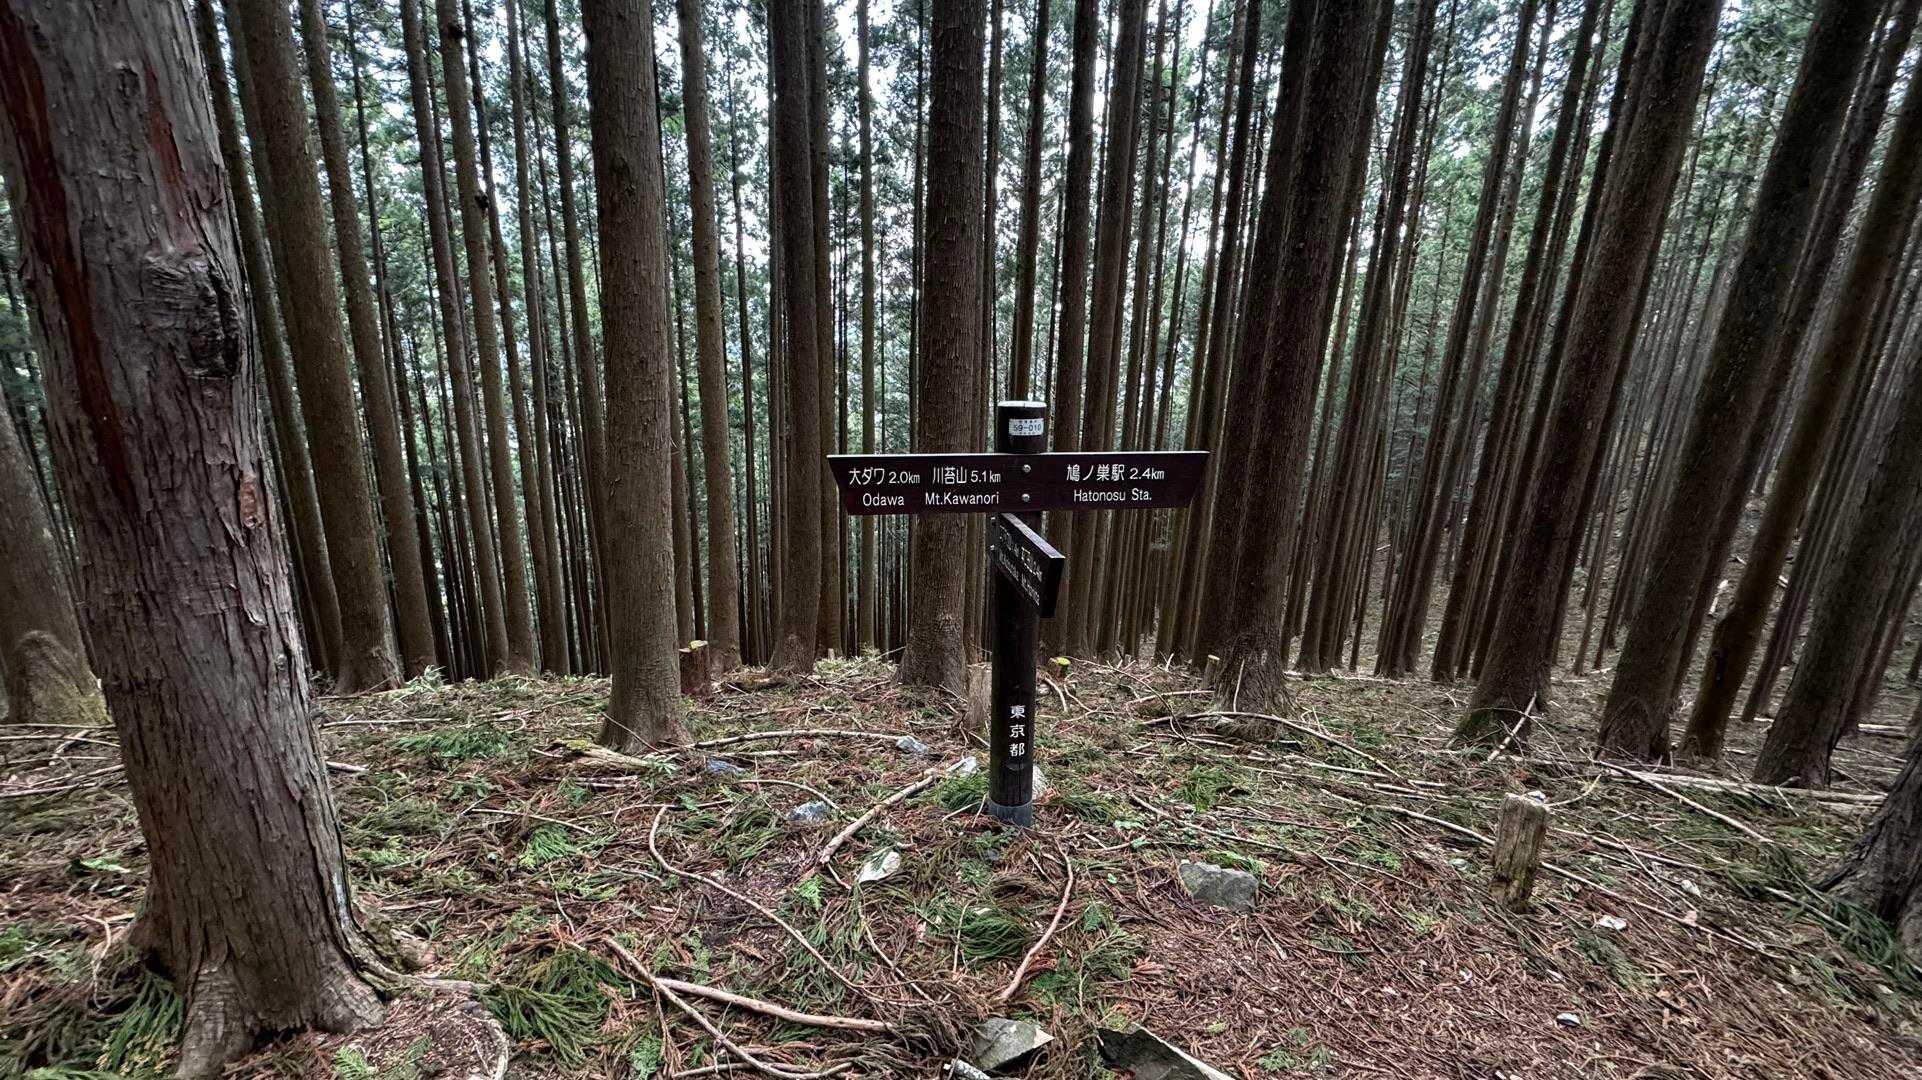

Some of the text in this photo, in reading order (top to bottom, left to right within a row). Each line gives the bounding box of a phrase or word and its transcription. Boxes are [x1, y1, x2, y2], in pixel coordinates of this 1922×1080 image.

[849, 466, 920, 485] 大ダワ 2.0km
[932, 466, 1001, 485] 川苔山 5.1km
[1066, 463, 1165, 482] 鳩ノ巣駅 2.4km
[862, 493, 905, 507] Odawa
[925, 491, 1000, 505] Mt.Kawanori
[1073, 487, 1152, 502] Hatonosu Sta.
[1009, 704, 1026, 757] 東京都
